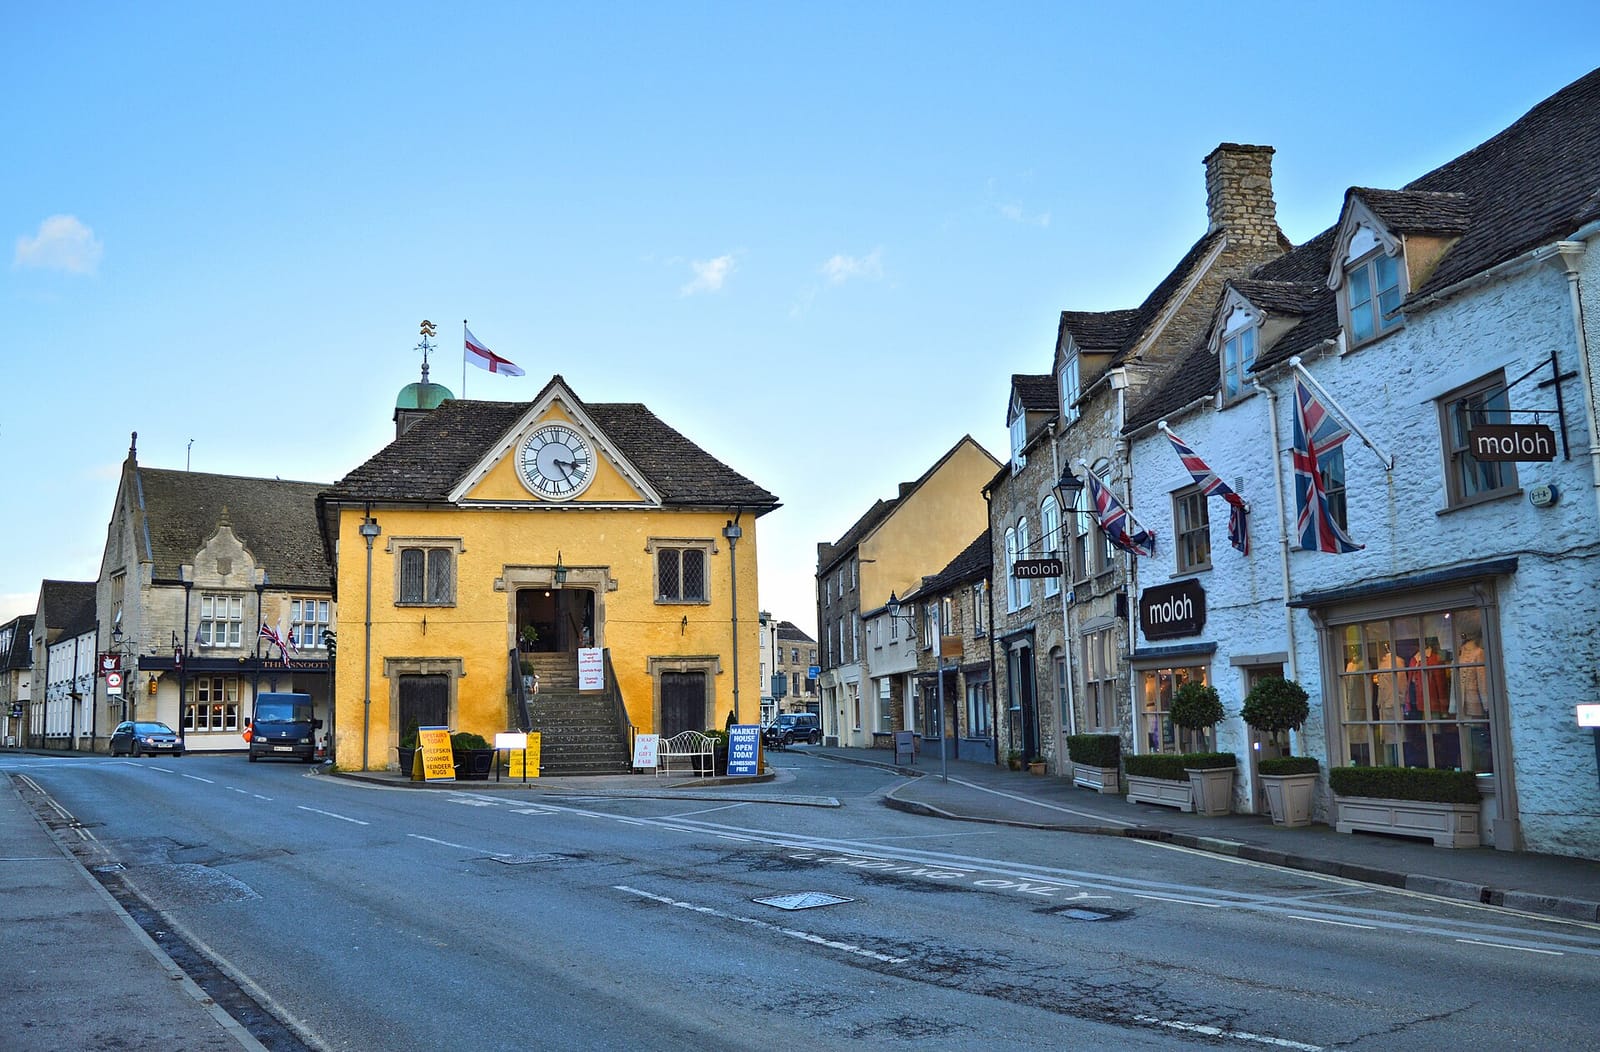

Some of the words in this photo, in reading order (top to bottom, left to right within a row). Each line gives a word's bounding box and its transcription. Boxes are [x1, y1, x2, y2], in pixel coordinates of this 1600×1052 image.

[1478, 431, 1549, 454] moloh
[1017, 562, 1059, 575] moloh
[1149, 593, 1193, 625] moloh
[733, 735, 756, 743] HOUSE
[733, 751, 754, 759] TODAY
[789, 853, 965, 879] LOADING
[973, 879, 1113, 900] ONLY
